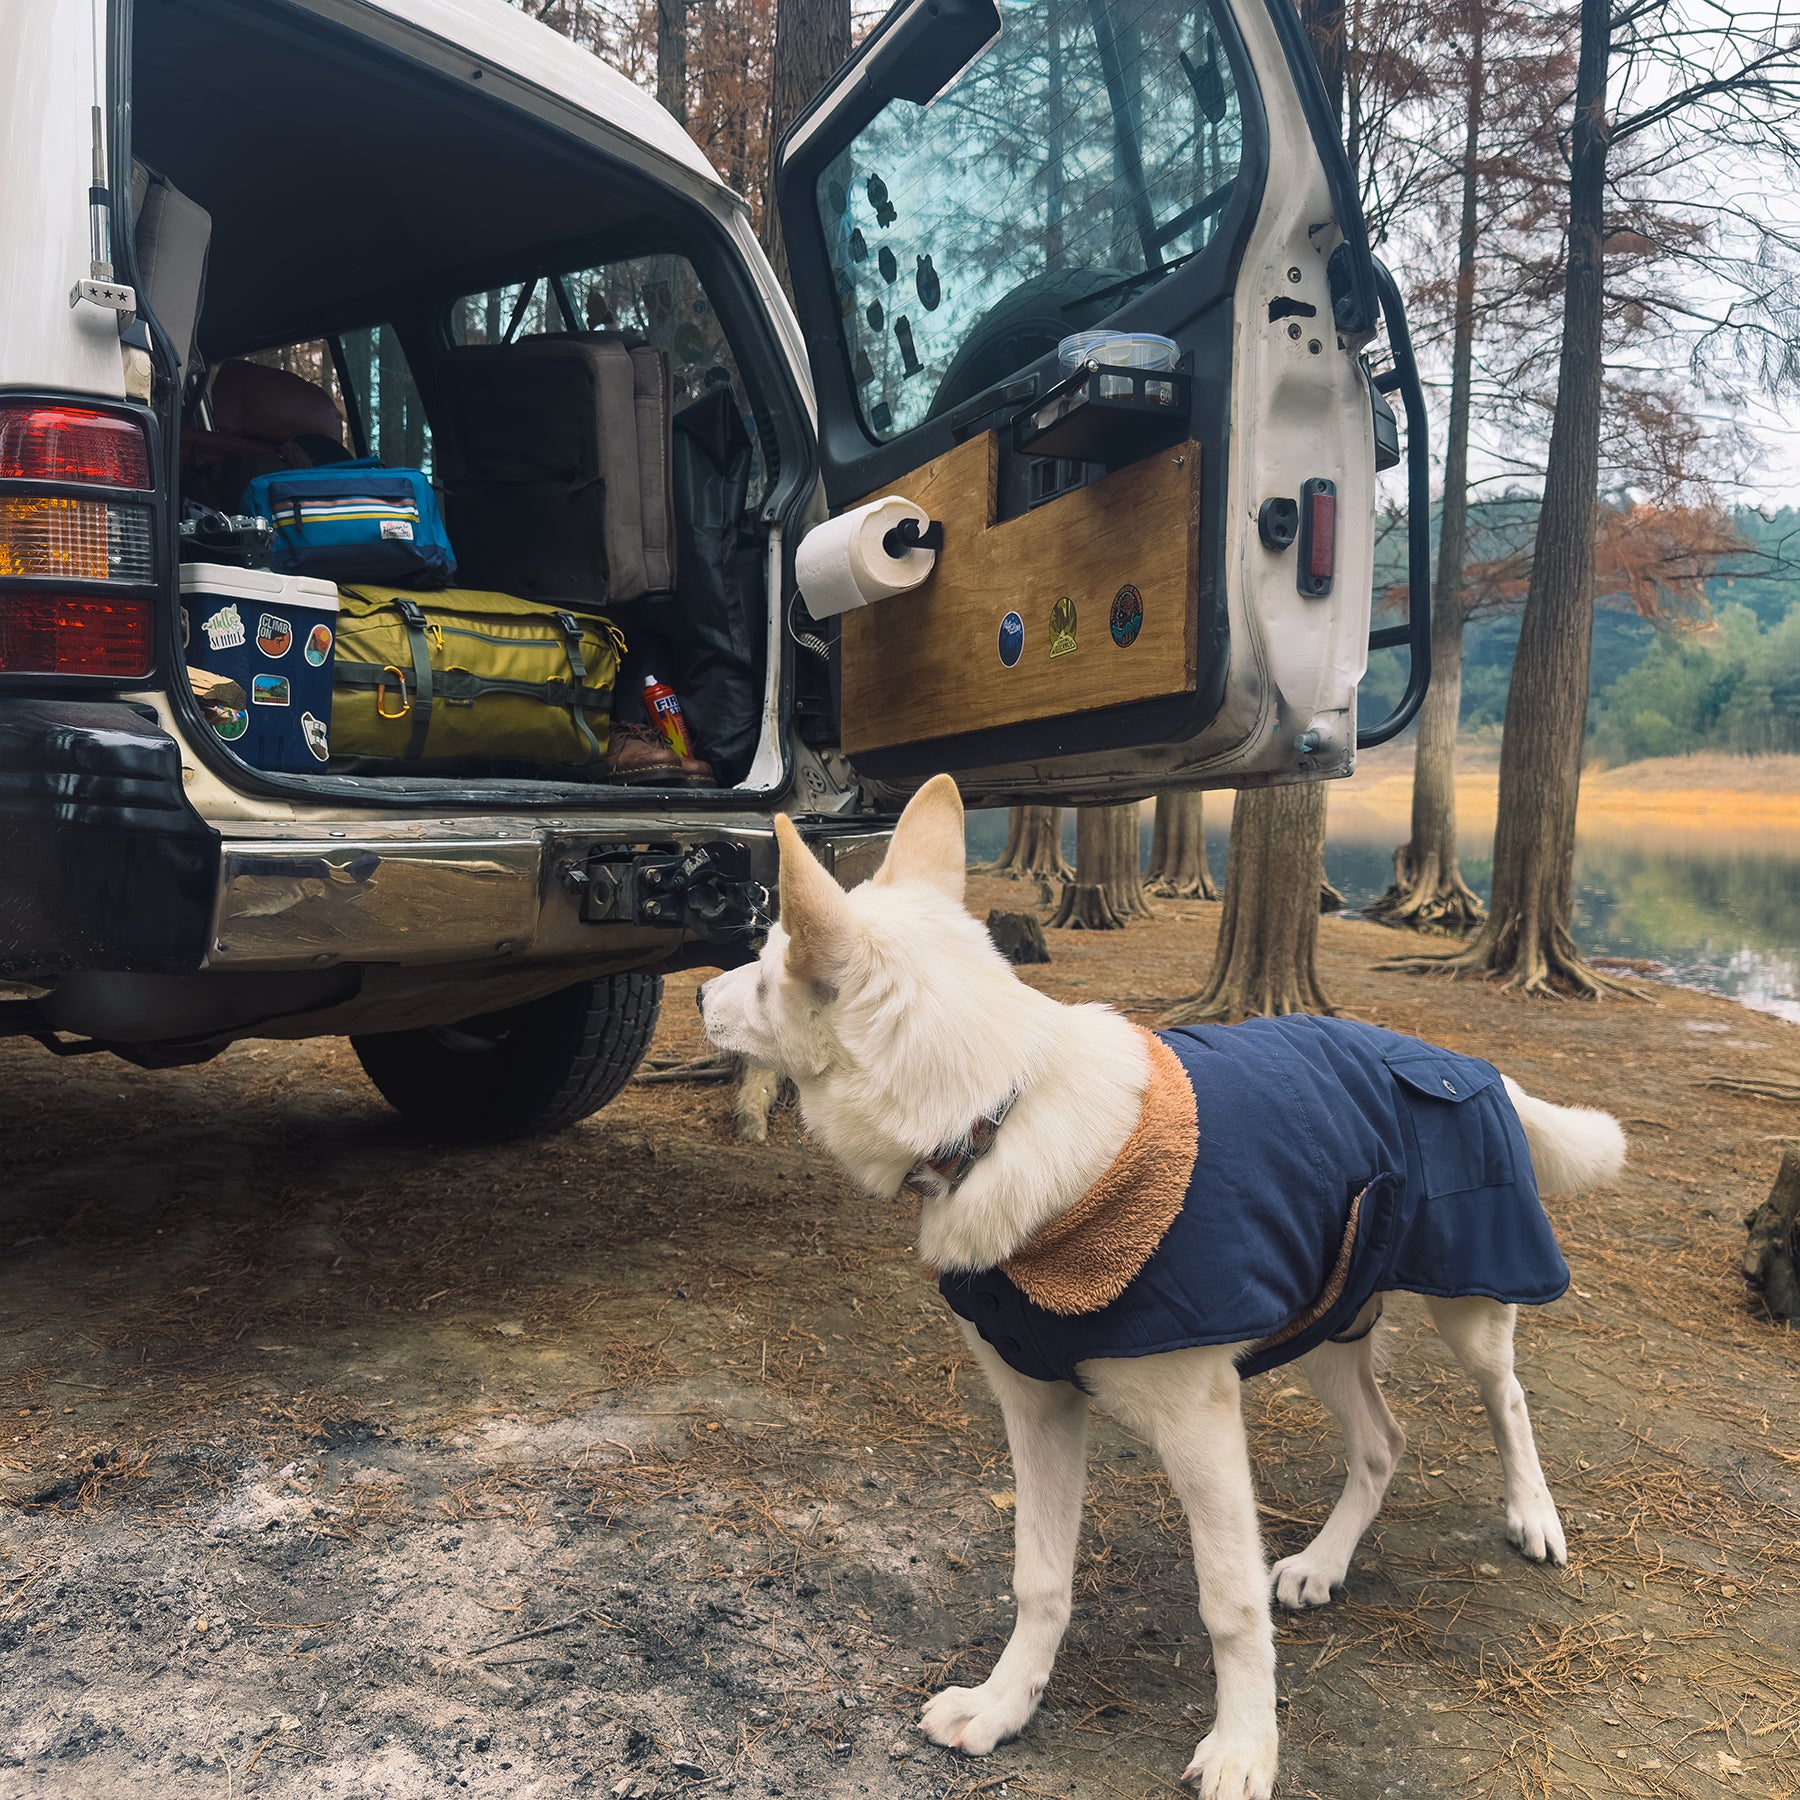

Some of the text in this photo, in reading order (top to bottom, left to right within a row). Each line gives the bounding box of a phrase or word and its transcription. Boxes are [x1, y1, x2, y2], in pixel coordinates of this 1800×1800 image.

[212, 609, 238, 630] Hello
[262, 616, 289, 634] CLIMB
[260, 627, 272, 640] ON
[655, 695, 679, 711] FIR
[669, 706, 681, 715] ST
